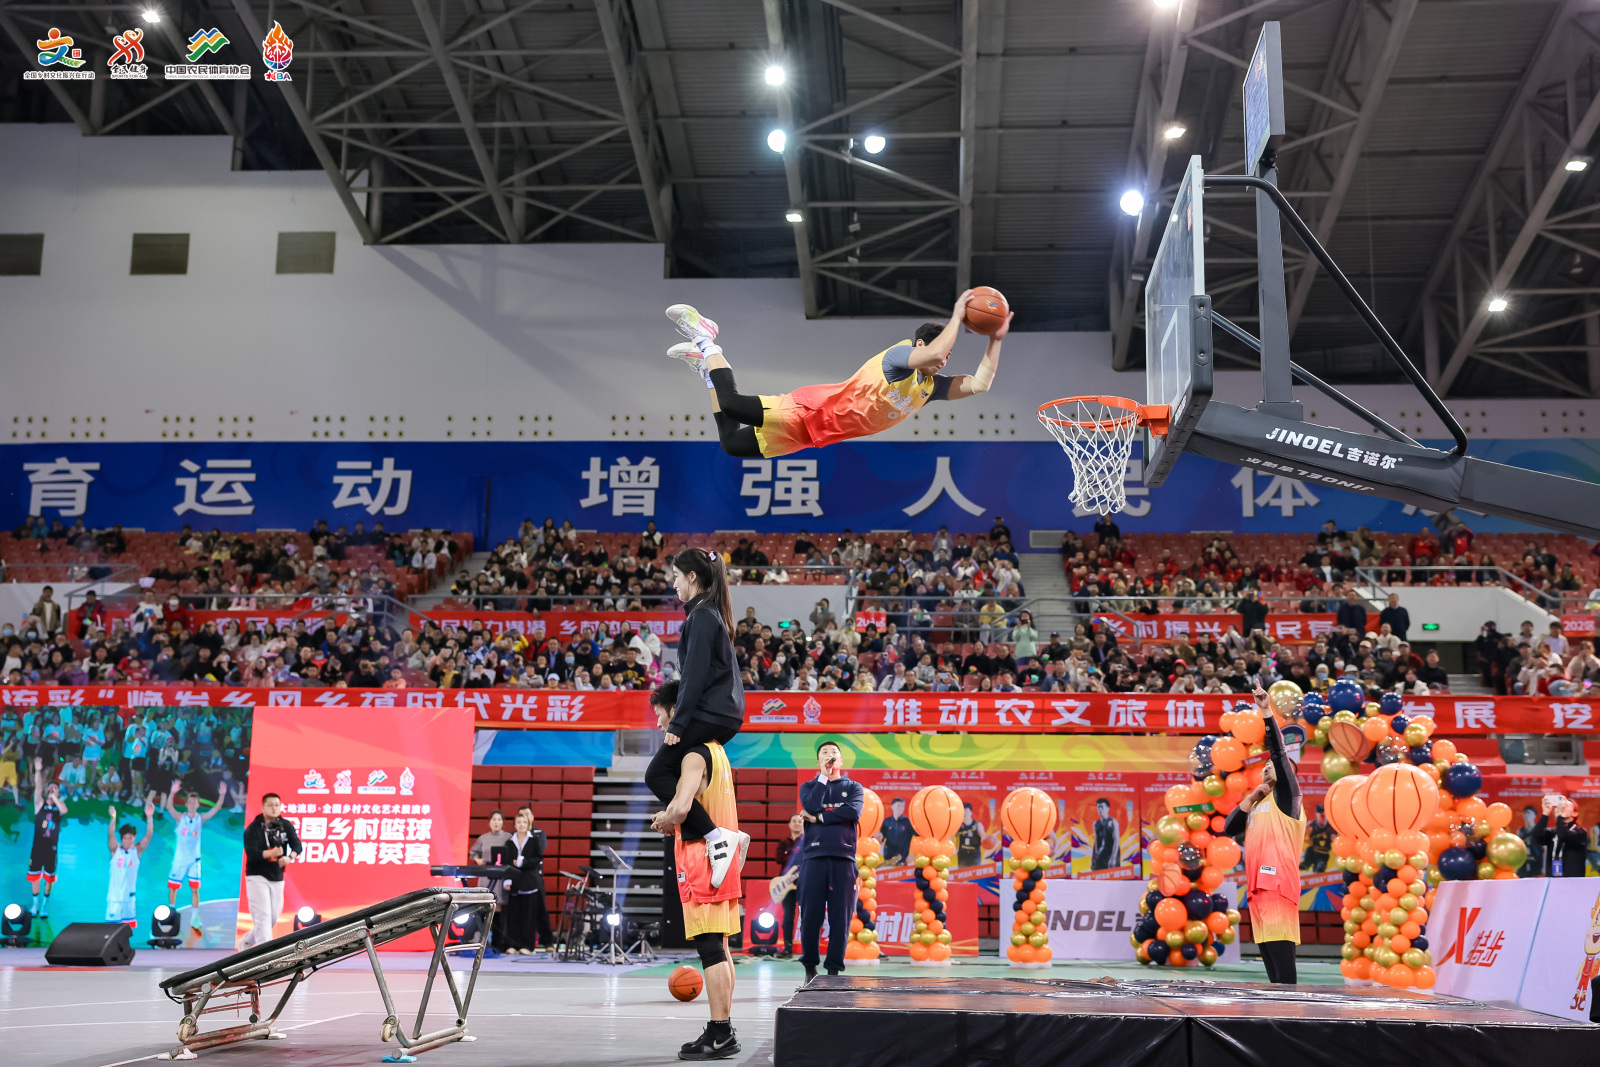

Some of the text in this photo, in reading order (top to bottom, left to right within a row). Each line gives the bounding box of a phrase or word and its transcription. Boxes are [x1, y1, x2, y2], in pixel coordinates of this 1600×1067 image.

[1265, 427, 1345, 458] JINOEL
[22, 456, 413, 517] 育运动
[883, 697, 1258, 728] 推动农文旅体
[1549, 702, 1594, 729] 挖
[1046, 910, 1132, 932] INOEL
